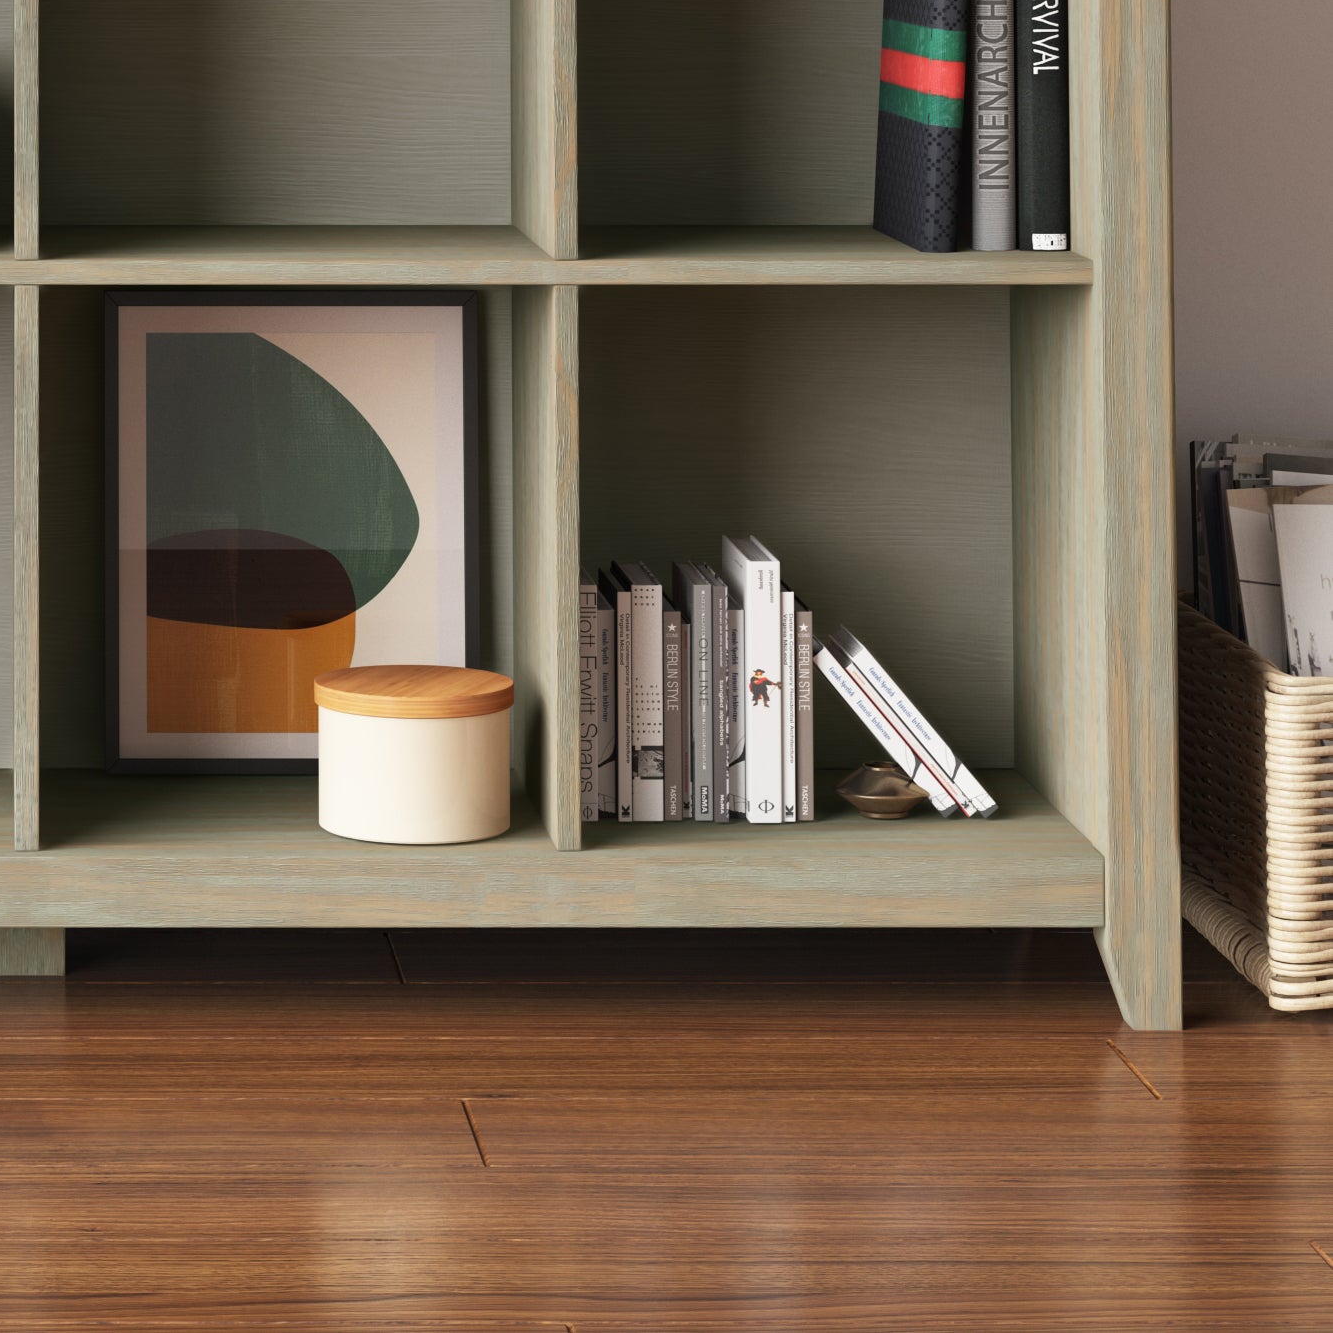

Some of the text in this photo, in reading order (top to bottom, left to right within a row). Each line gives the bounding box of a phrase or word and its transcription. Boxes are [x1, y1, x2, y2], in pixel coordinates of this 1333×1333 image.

[667, 644, 678, 678] BERLIN
[698, 638, 709, 662] ON
[798, 644, 810, 679] BERLIN
[579, 591, 598, 793] Elliott Erwitt Snaps
[667, 681, 678, 711] STYLE
[698, 669, 709, 707] LINE
[798, 681, 810, 711] STYLE
[700, 786, 708, 814] MoMA
